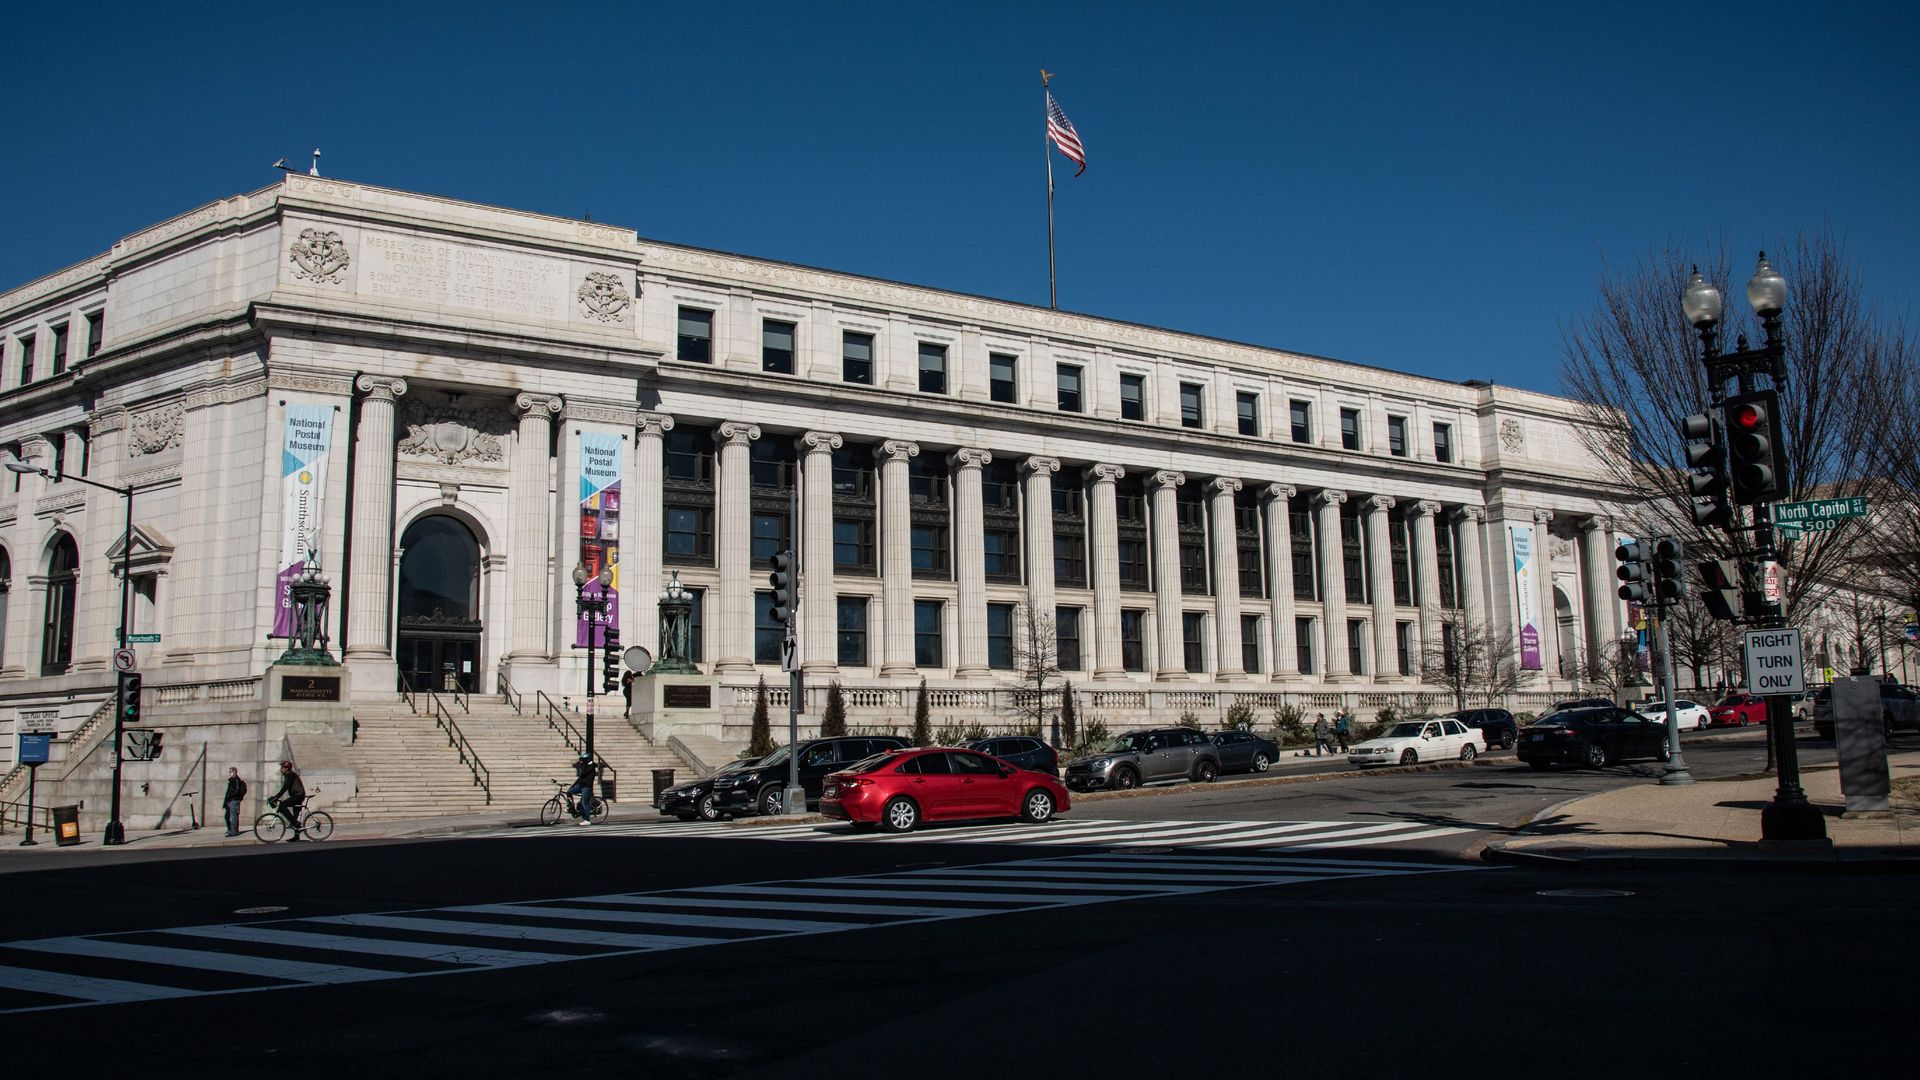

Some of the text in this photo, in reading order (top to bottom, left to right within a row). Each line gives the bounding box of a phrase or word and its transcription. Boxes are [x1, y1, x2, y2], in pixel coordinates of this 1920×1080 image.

[538, 264, 564, 275] LOVE
[369, 271, 400, 284] BOND
[290, 418, 325, 429] National
[295, 430, 321, 440] Postal
[289, 441, 325, 451] Museum
[585, 446, 615, 457] National
[589, 457, 612, 467] Postal
[585, 467, 617, 477] Museum
[1779, 504, 1808, 519] North
[1812, 500, 1850, 518] Capitol
[297, 490, 309, 555] Smithsonian
[1806, 520, 1836, 531] 500
[583, 611, 613, 624] Gllery
[1752, 634, 1793, 648] RIGHT
[1756, 655, 1793, 668] TURN
[308, 680, 315, 689] 2
[1759, 675, 1792, 688] ONLY
